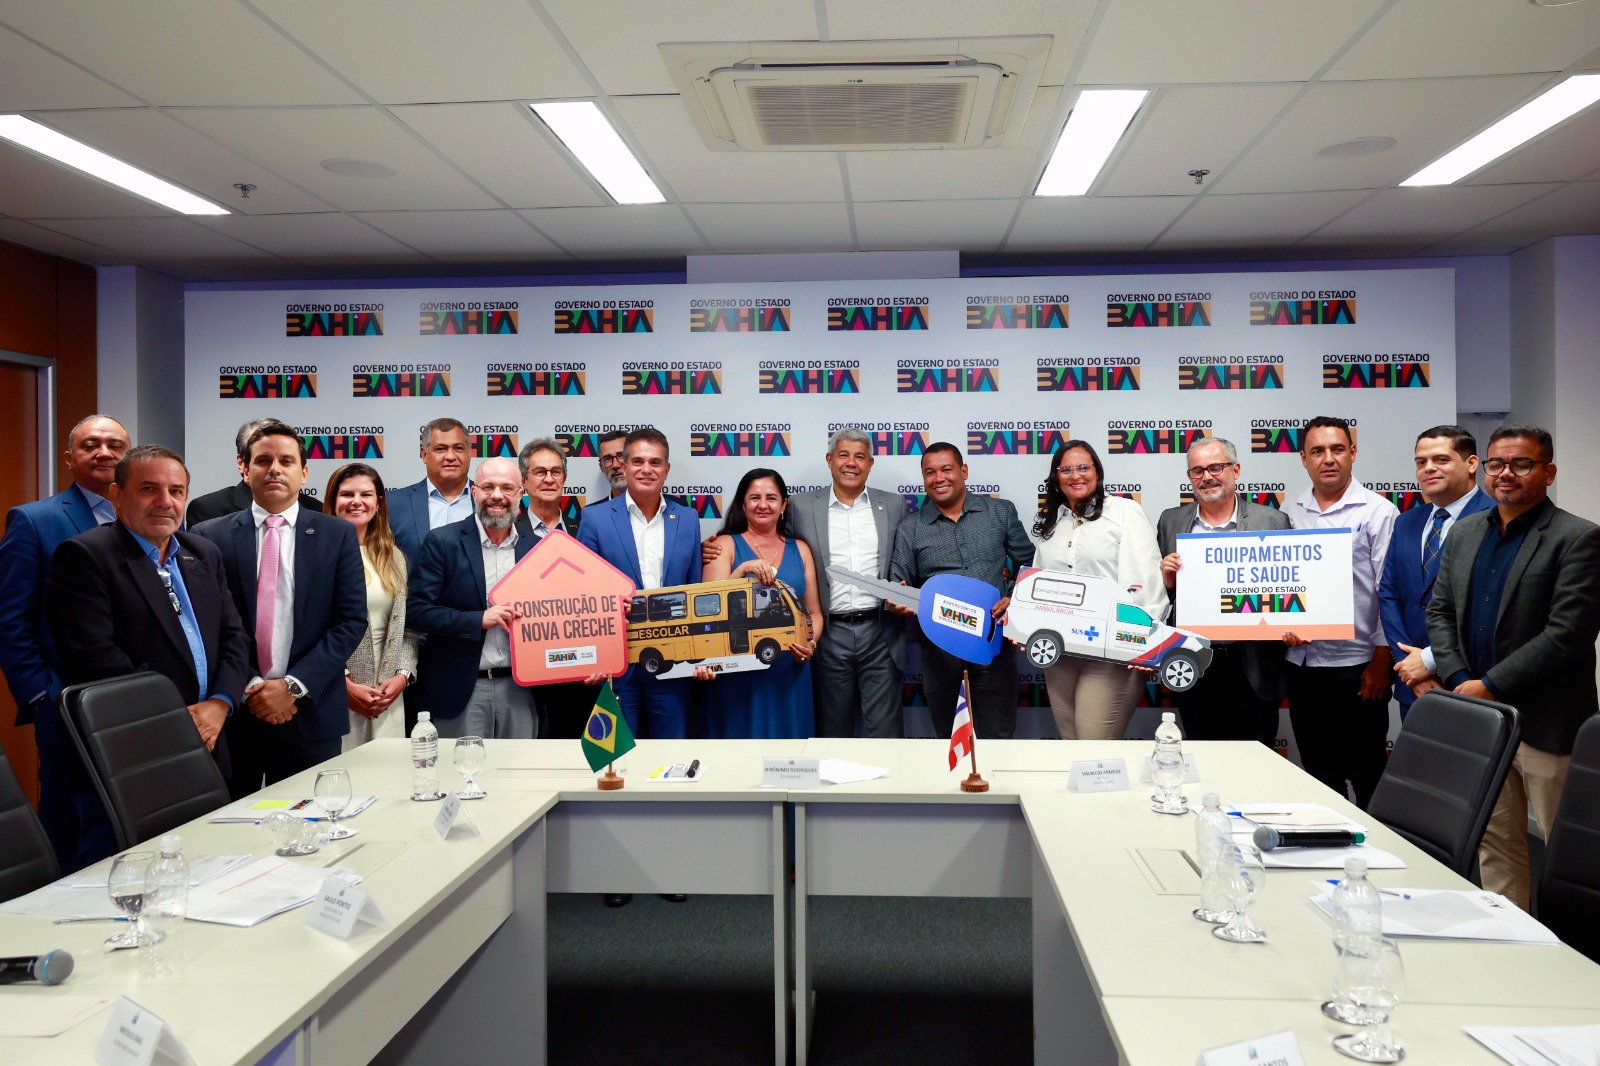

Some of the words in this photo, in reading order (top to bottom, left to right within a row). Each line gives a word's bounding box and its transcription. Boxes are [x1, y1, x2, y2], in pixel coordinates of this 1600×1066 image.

[967, 296, 1014, 304] GOVERNO
[1016, 296, 1030, 304] DO
[1033, 295, 1069, 303] ESTADO
[1107, 294, 1155, 302] GOVERNO
[1174, 293, 1211, 301] ESTADO
[1250, 292, 1299, 300] GOVERNO
[1301, 291, 1316, 299] DO
[1319, 290, 1356, 299] ESTADO
[555, 300, 600, 309] GOVERNO
[603, 300, 616, 308] DO
[619, 300, 653, 308] ESTADO
[690, 299, 736, 308] GOVERNO
[739, 299, 752, 307] DO
[755, 299, 790, 307] ESTADO
[828, 298, 874, 306] GOVERNO
[877, 297, 890, 306] DO
[893, 297, 928, 305] ESTADO
[287, 304, 331, 312] GOVERNO
[333, 304, 346, 312] DO
[349, 304, 383, 312] ESTADO
[420, 303, 465, 311] GOVERNO
[467, 302, 481, 310] DO
[484, 302, 518, 310] ESTADO
[967, 304, 1069, 329] BAHIA
[1107, 302, 1211, 327] BAHIA
[1250, 300, 1356, 325] BAHIA
[555, 309, 653, 334] BAHIA
[690, 308, 790, 332] BAHIA
[828, 306, 928, 331] BAHIA
[287, 313, 383, 336] BAHIA
[420, 312, 518, 335] BAHIA
[1037, 358, 1084, 366] GOVERNO
[1087, 357, 1101, 365] DO
[1104, 357, 1140, 365] ESTADO
[1179, 356, 1227, 364] GOVERNO
[1230, 356, 1244, 364] DO
[1374, 354, 1389, 362] DO
[1392, 354, 1429, 362] ESTADO
[487, 363, 532, 371] GOVERNO
[535, 363, 548, 371] DO
[551, 362, 585, 370] ESTADO
[622, 362, 668, 370] GOVERNO
[670, 362, 684, 370] DO
[687, 362, 722, 370] ESTADO
[759, 361, 805, 369] GOVERNO
[808, 360, 821, 368] DO
[824, 360, 860, 368] ESTADO
[897, 360, 944, 368] GOVERNO
[946, 359, 960, 367] DO
[963, 359, 999, 367] ESTADO
[220, 366, 264, 374] GOVERNO
[267, 366, 280, 374] DO
[283, 365, 317, 373] ESTADO
[353, 365, 398, 373] GOVERNO
[400, 364, 413, 372] DO
[416, 364, 450, 372] ESTADO
[897, 368, 999, 392] BAHIA
[1037, 366, 1140, 391] BAHIA
[1179, 365, 1284, 390] BAHIA
[1323, 363, 1429, 388] BAHIA
[220, 374, 317, 398] BAHIA
[353, 373, 450, 397] BAHIA
[487, 372, 585, 396] BAHIA
[622, 370, 722, 394] BAHIA
[759, 370, 860, 393] BAHIA
[603, 424, 616, 432] DO
[691, 424, 736, 432] GOVERNO
[756, 423, 791, 431] ESTADO
[828, 423, 874, 431] GOVERNO
[894, 422, 930, 430] ESTADO
[967, 422, 1014, 430] GOVERNO
[1034, 421, 1070, 429] ESTADO
[1158, 420, 1172, 428] DO
[1175, 420, 1212, 428] ESTADO
[333, 426, 347, 434] DO
[350, 426, 384, 434] ESTADO
[303, 436, 384, 459] AHIA
[691, 432, 791, 456] BAHIA
[671, 486, 685, 494] DO
[688, 486, 722, 494] ESTADO
[898, 485, 927, 493] GOVE
[1105, 484, 1141, 492] ESTADO
[1248, 483, 1285, 491] ESTADO
[1394, 482, 1421, 490] ESTA
[1205, 544, 1323, 564] EQUIPAMENTOS
[1227, 567, 1245, 583] DE
[1251, 564, 1300, 583] SAÚDE
[514, 594, 598, 622] CONSTRUÇÃO
[602, 595, 618, 613] DE
[1220, 594, 1306, 613] BAHIA
[1035, 604, 1074, 615] AMBULÂNCIA
[521, 621, 560, 643] NOVA
[564, 616, 616, 639] CRECHE
[638, 625, 689, 640] ESCOLAR
[1116, 632, 1147, 645] BAHIA
[549, 653, 577, 662] BAHIA
